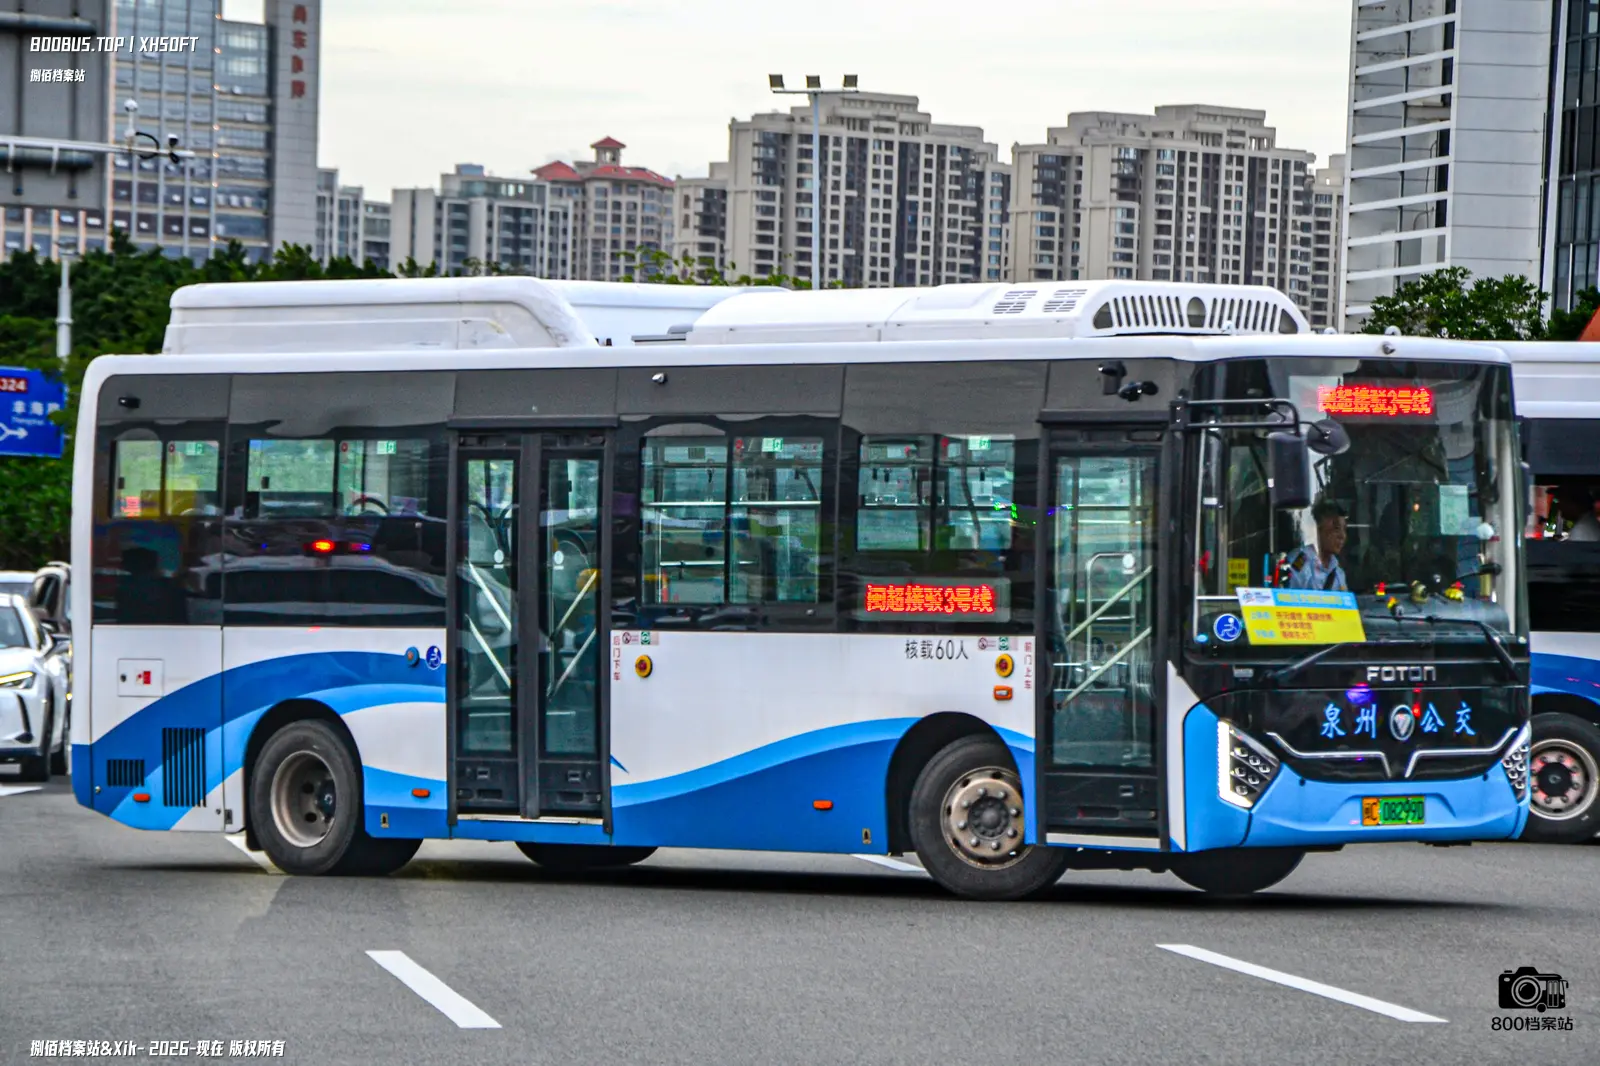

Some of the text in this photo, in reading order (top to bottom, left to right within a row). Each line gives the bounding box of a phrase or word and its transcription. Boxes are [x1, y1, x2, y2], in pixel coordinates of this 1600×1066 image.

[865, 584, 995, 614] 闽超接驳3号线
[905, 639, 969, 660] 核载60人
[1366, 666, 1437, 681] FOTON
[1320, 701, 1477, 739] 泉州 公交
